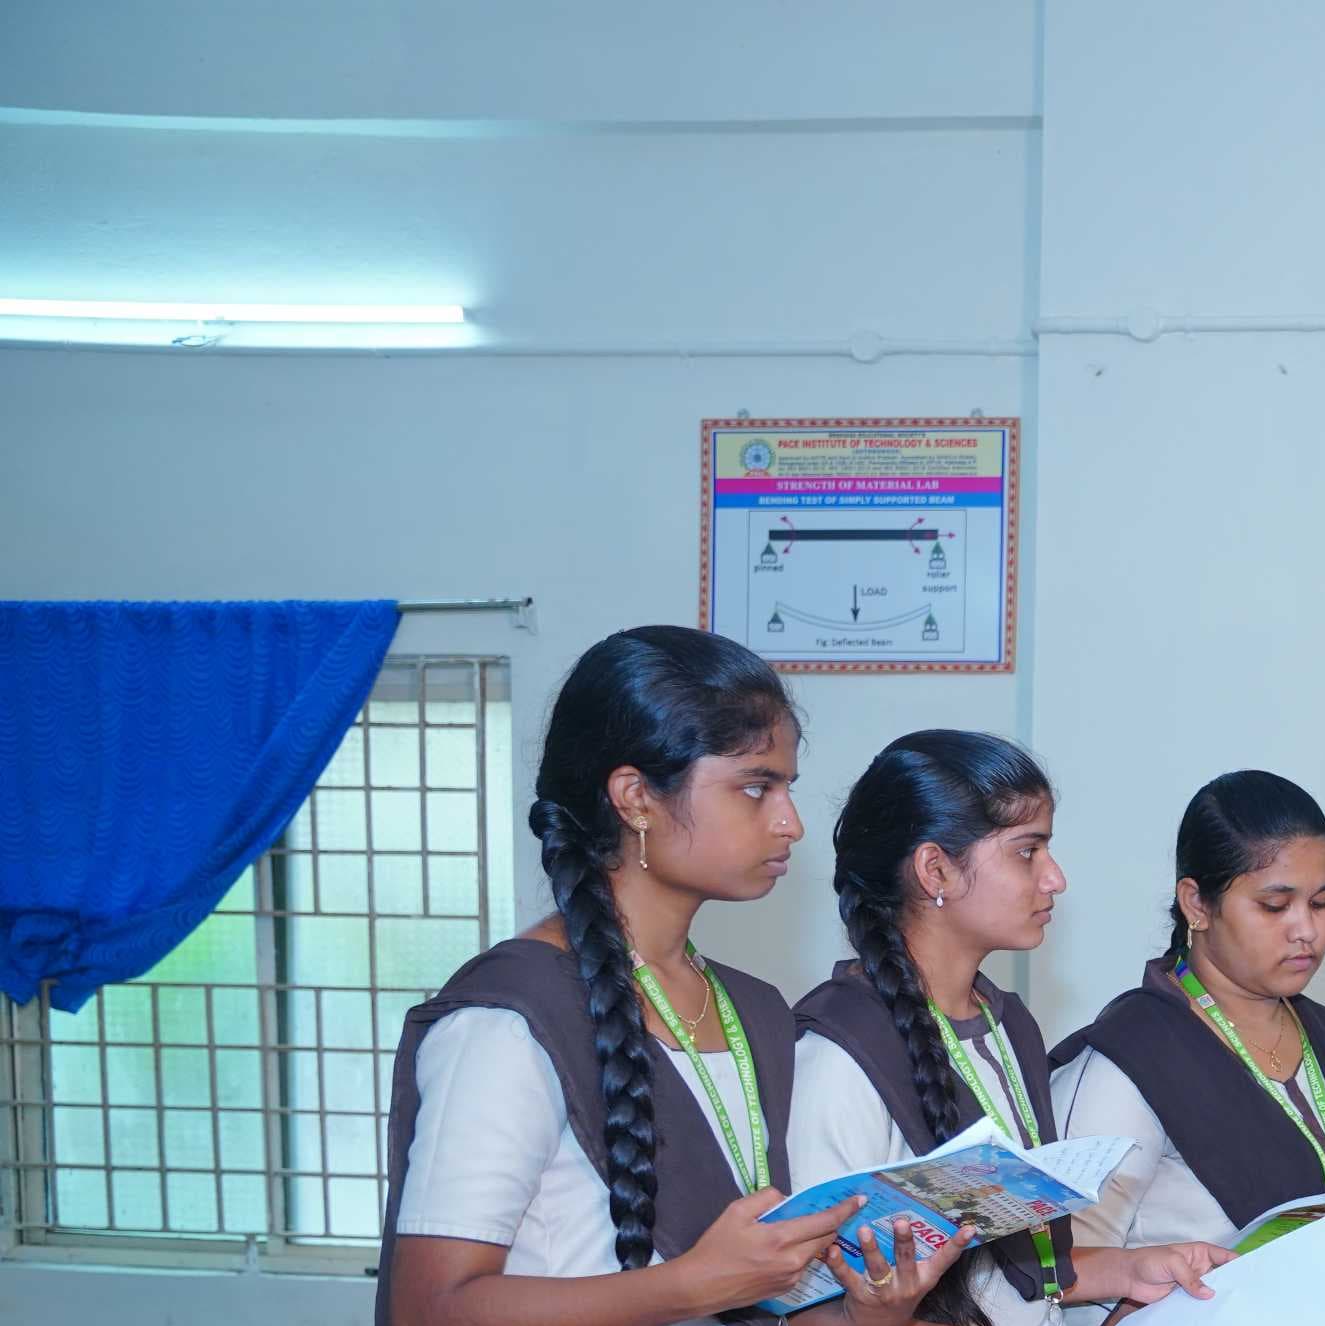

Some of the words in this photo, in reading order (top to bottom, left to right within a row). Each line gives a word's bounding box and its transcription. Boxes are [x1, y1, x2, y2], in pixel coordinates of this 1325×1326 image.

[777, 439, 800, 449] PACE
[802, 439, 848, 449] INSTITUTE
[850, 439, 862, 449] OF
[864, 438, 923, 449] TECHNOLOGY
[934, 438, 978, 448] SCIENCES
[776, 480, 836, 491] STRENGTH
[838, 480, 853, 491] OF
[855, 480, 914, 491] MATERIAL
[916, 479, 939, 490] LAB
[758, 495, 799, 506] BENDING
[800, 495, 820, 506] TEST
[825, 496, 836, 505] OF
[836, 495, 871, 506] SIMPLY
[873, 494, 928, 505] SUPPORTED
[928, 494, 955, 505] BEAM
[753, 563, 784, 574] pinned
[926, 570, 951, 578] roller
[861, 587, 888, 597] LOAD
[922, 585, 958, 594] support
[831, 638, 869, 647] Deflected
[871, 638, 893, 647] Beam
[640, 975, 680, 1028] SCIENCES
[1211, 1010, 1243, 1049] SCIENCES
[729, 1036, 756, 1108] TECHNOLOGY
[1029, 1199, 1059, 1217] PACE
